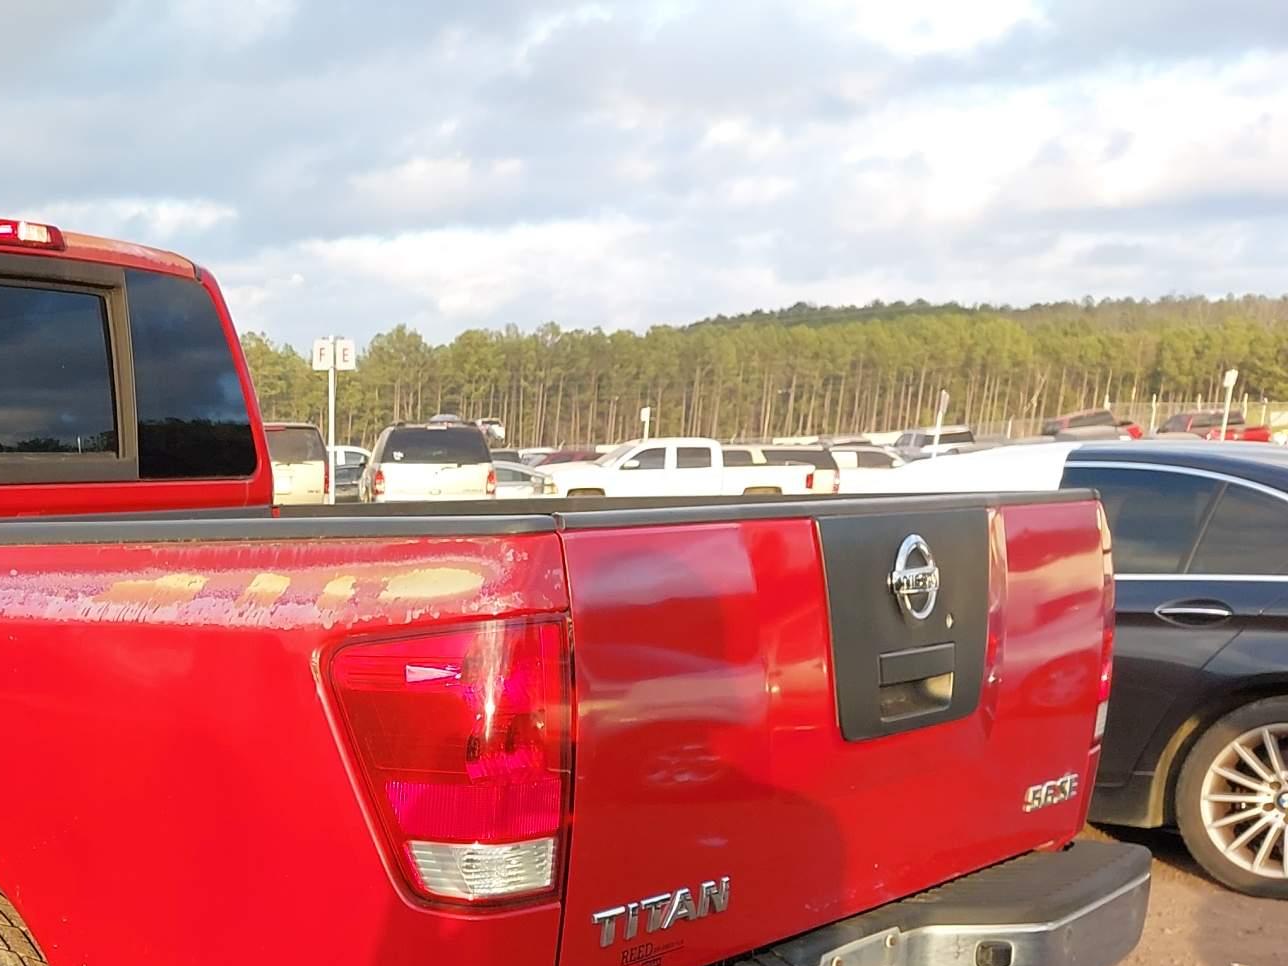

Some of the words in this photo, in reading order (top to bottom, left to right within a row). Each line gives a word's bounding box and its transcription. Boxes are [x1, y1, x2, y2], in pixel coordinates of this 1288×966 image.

[319, 347, 326, 363] F
[342, 347, 350, 363] E
[592, 876, 730, 948] TITAN
[620, 942, 654, 966] REED
